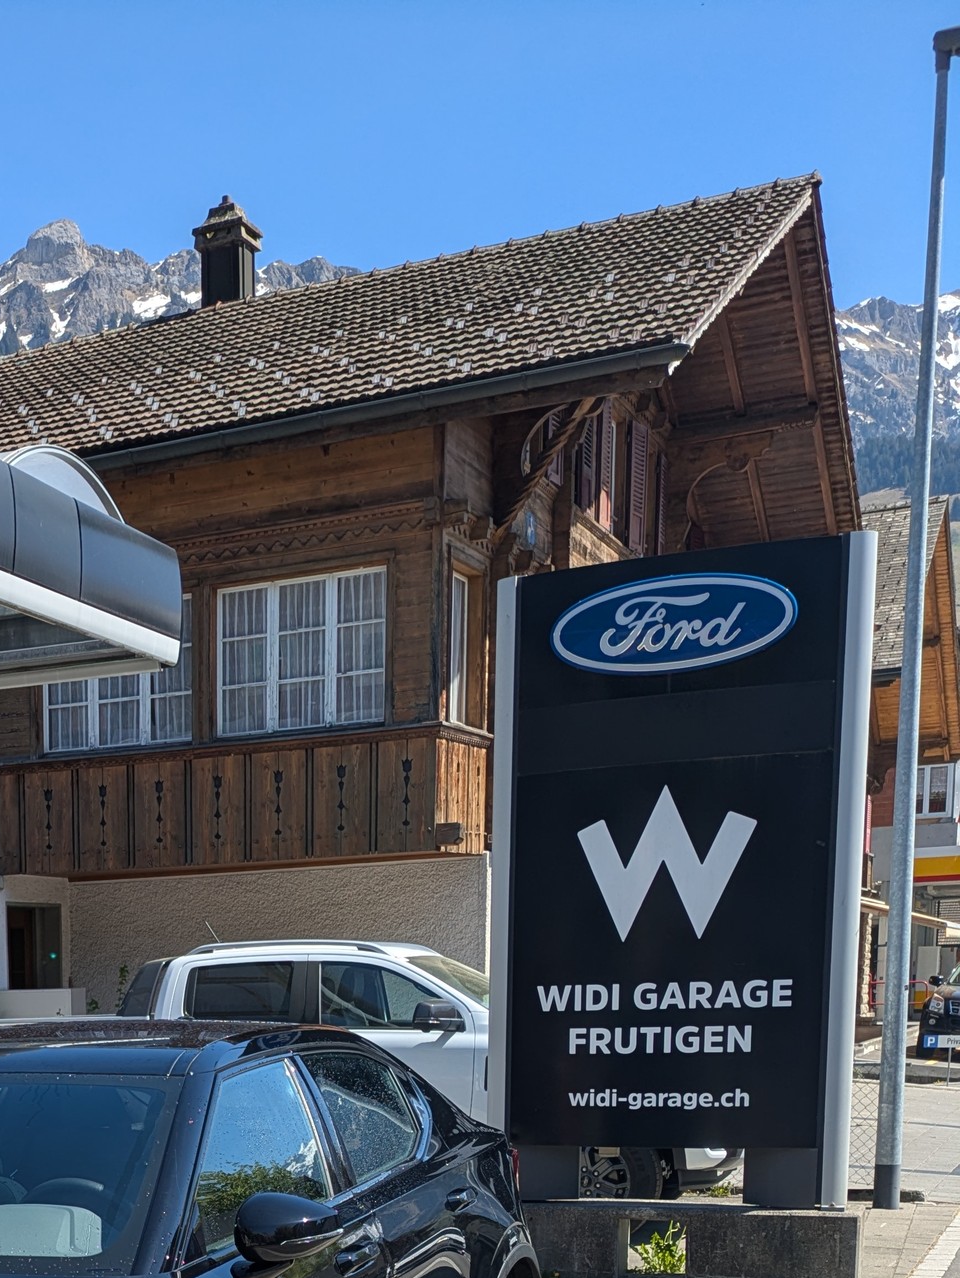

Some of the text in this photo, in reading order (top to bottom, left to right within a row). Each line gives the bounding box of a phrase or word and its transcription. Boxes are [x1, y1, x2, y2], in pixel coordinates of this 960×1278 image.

[599, 591, 747, 657] Ford
[576, 784, 758, 943] W
[537, 978, 793, 1012] WIDI GARAGE
[568, 1024, 753, 1055] FRUTIGEN
[927, 1036, 936, 1047] P
[568, 1088, 750, 1110] widi-garage.ch
